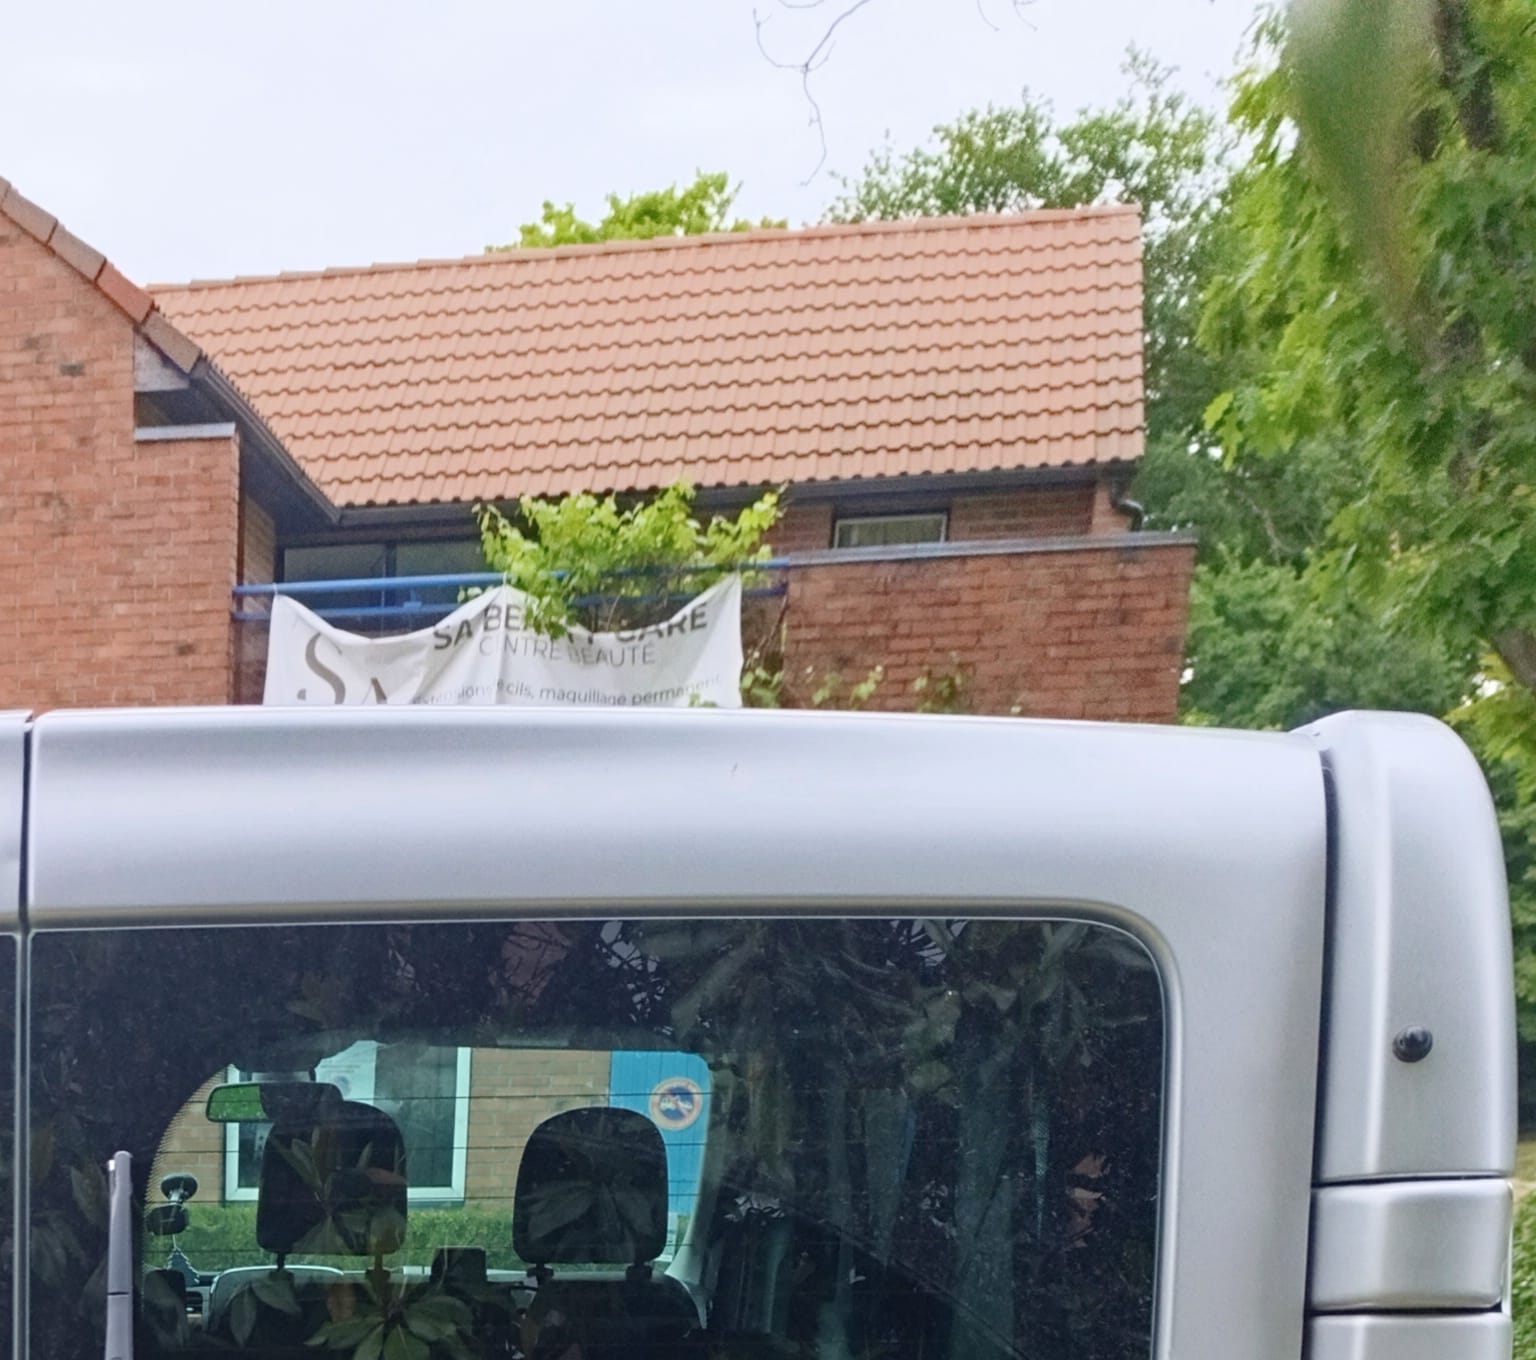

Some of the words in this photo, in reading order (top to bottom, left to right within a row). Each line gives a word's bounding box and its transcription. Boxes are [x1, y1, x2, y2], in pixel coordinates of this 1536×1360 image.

[433, 618, 474, 650] SA
[479, 634, 561, 660] CNTRE
[539, 686, 628, 706] maquillage
